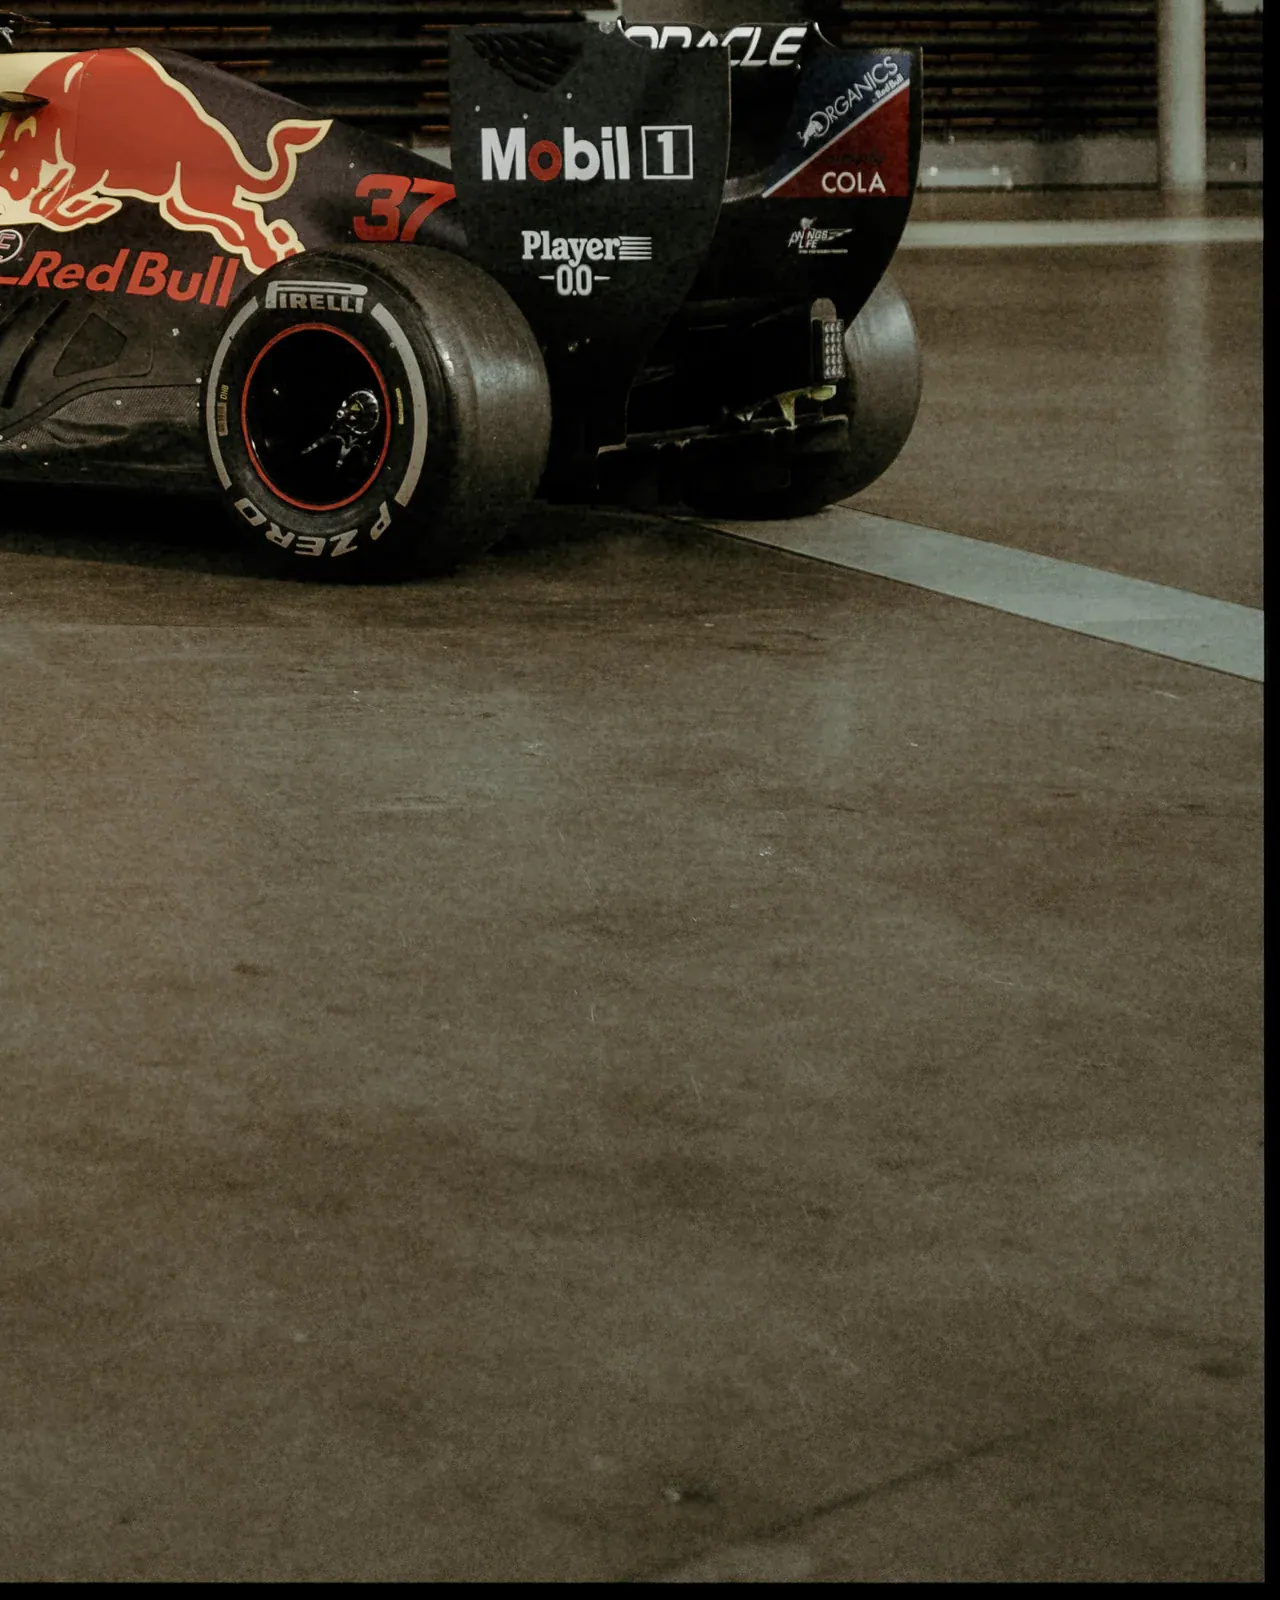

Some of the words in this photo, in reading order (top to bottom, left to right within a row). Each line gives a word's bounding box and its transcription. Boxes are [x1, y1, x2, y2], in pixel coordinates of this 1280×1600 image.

[808, 56, 898, 137] ORGANICS
[481, 126, 630, 181] Mobil
[657, 131, 674, 174] 1
[352, 174, 457, 242] 37
[821, 171, 887, 194] COLA
[521, 230, 621, 267] Player
[18, 248, 131, 293] Red
[125, 250, 240, 308] Bull
[265, 280, 368, 313] PIRELLI
[234, 497, 359, 557] ZERO
[370, 501, 392, 541] P
